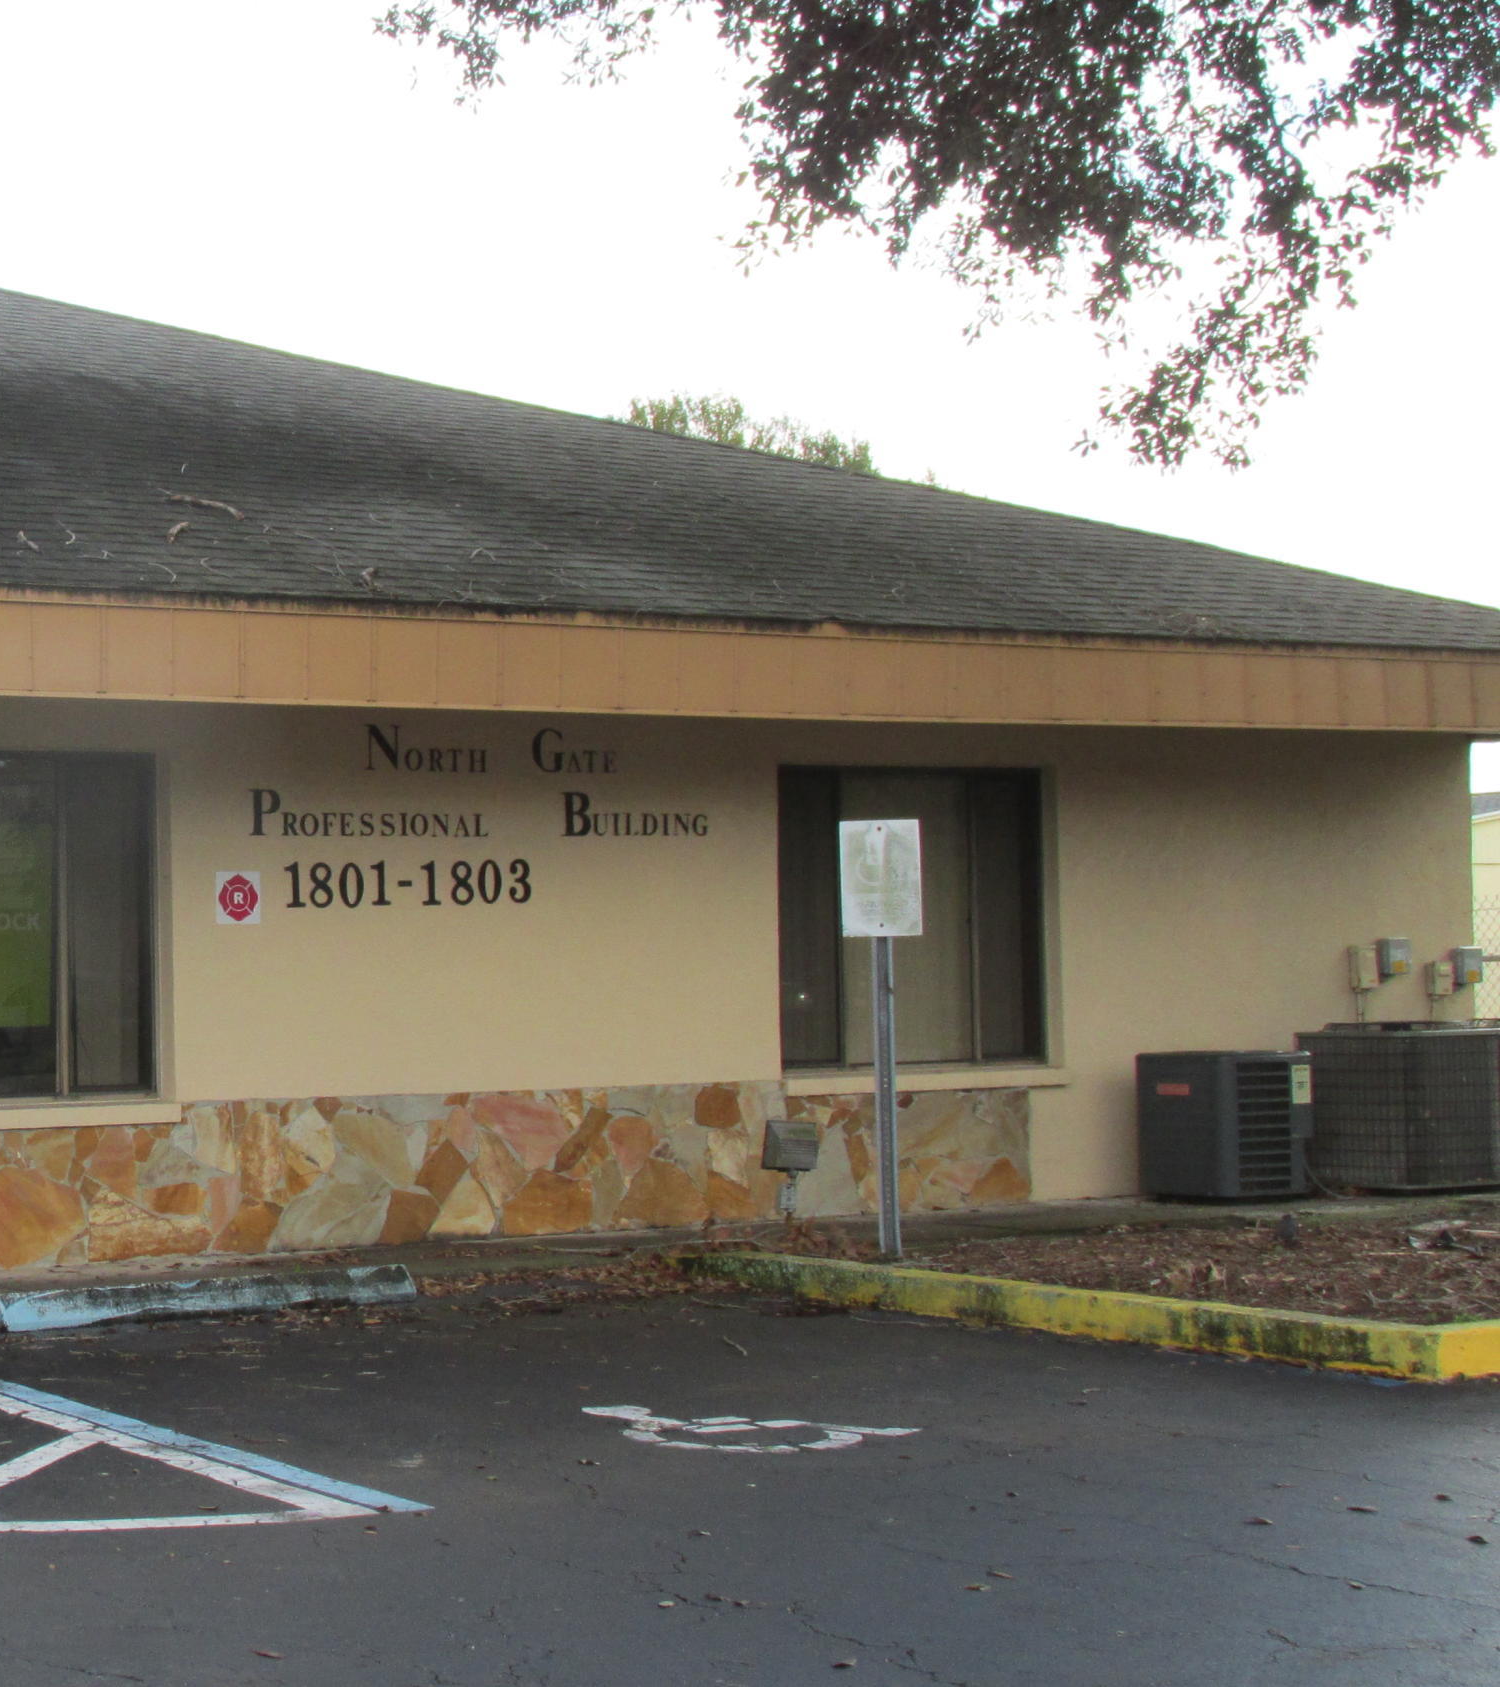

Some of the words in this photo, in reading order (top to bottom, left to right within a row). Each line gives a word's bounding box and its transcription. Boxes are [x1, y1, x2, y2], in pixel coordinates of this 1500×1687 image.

[364, 724, 487, 773] NORTH
[532, 728, 617, 774] GATE
[249, 789, 489, 837] PROFESSIONAL
[562, 791, 709, 837] BUILDING
[233, 891, 245, 904] R
[284, 858, 532, 909] 1801-1803
